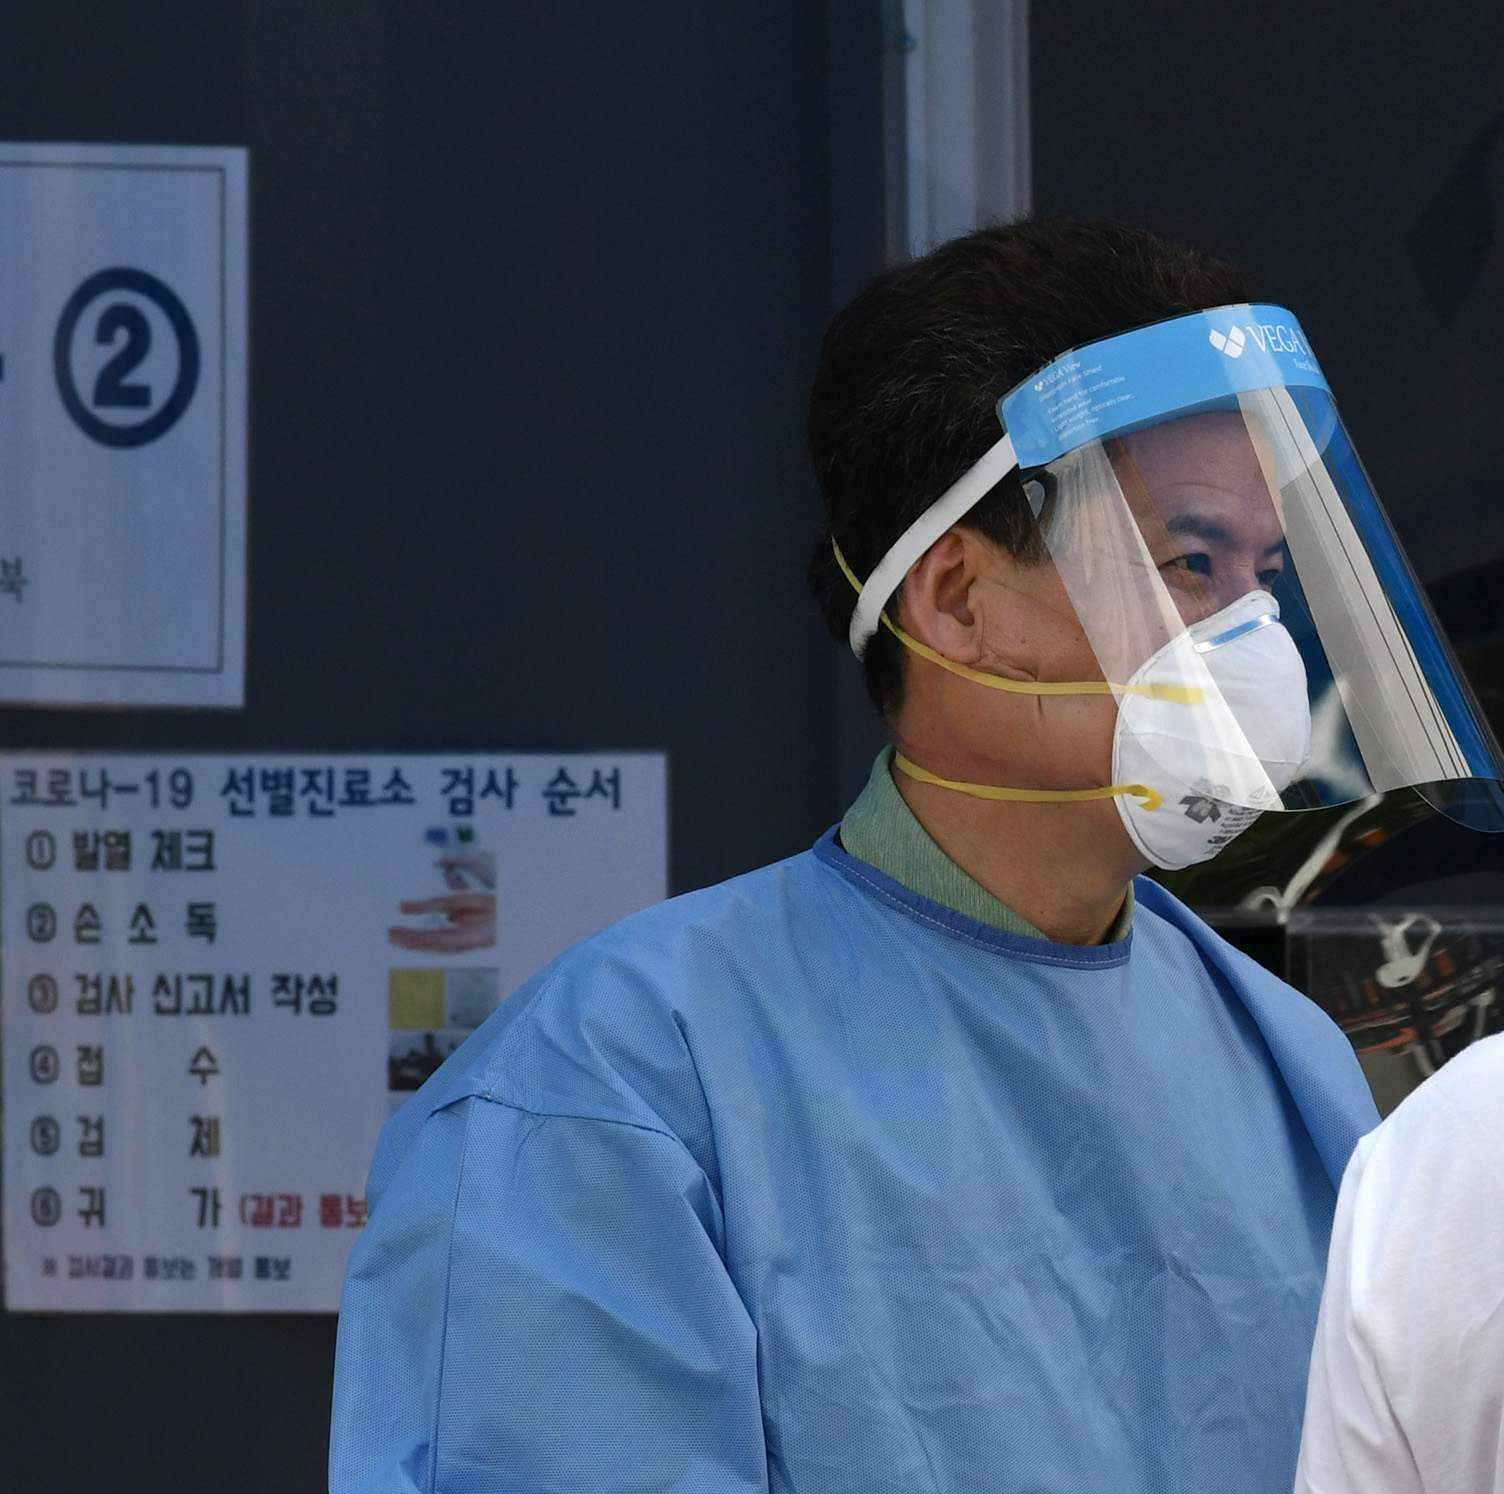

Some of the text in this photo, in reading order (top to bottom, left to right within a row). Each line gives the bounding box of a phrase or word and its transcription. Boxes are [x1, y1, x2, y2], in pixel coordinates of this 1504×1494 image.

[1245, 325, 1306, 356] VEGA
[12, 767, 622, 816] 코로나-19 선별진료소 검사 순서
[72, 830, 132, 871] 발열
[150, 830, 217, 871] 체크
[75, 973, 134, 1016] 검사
[152, 973, 251, 1016] 신고서
[271, 973, 338, 1016] 작성
[188, 1046, 220, 1086] 수
[188, 1187, 221, 1228] 가
